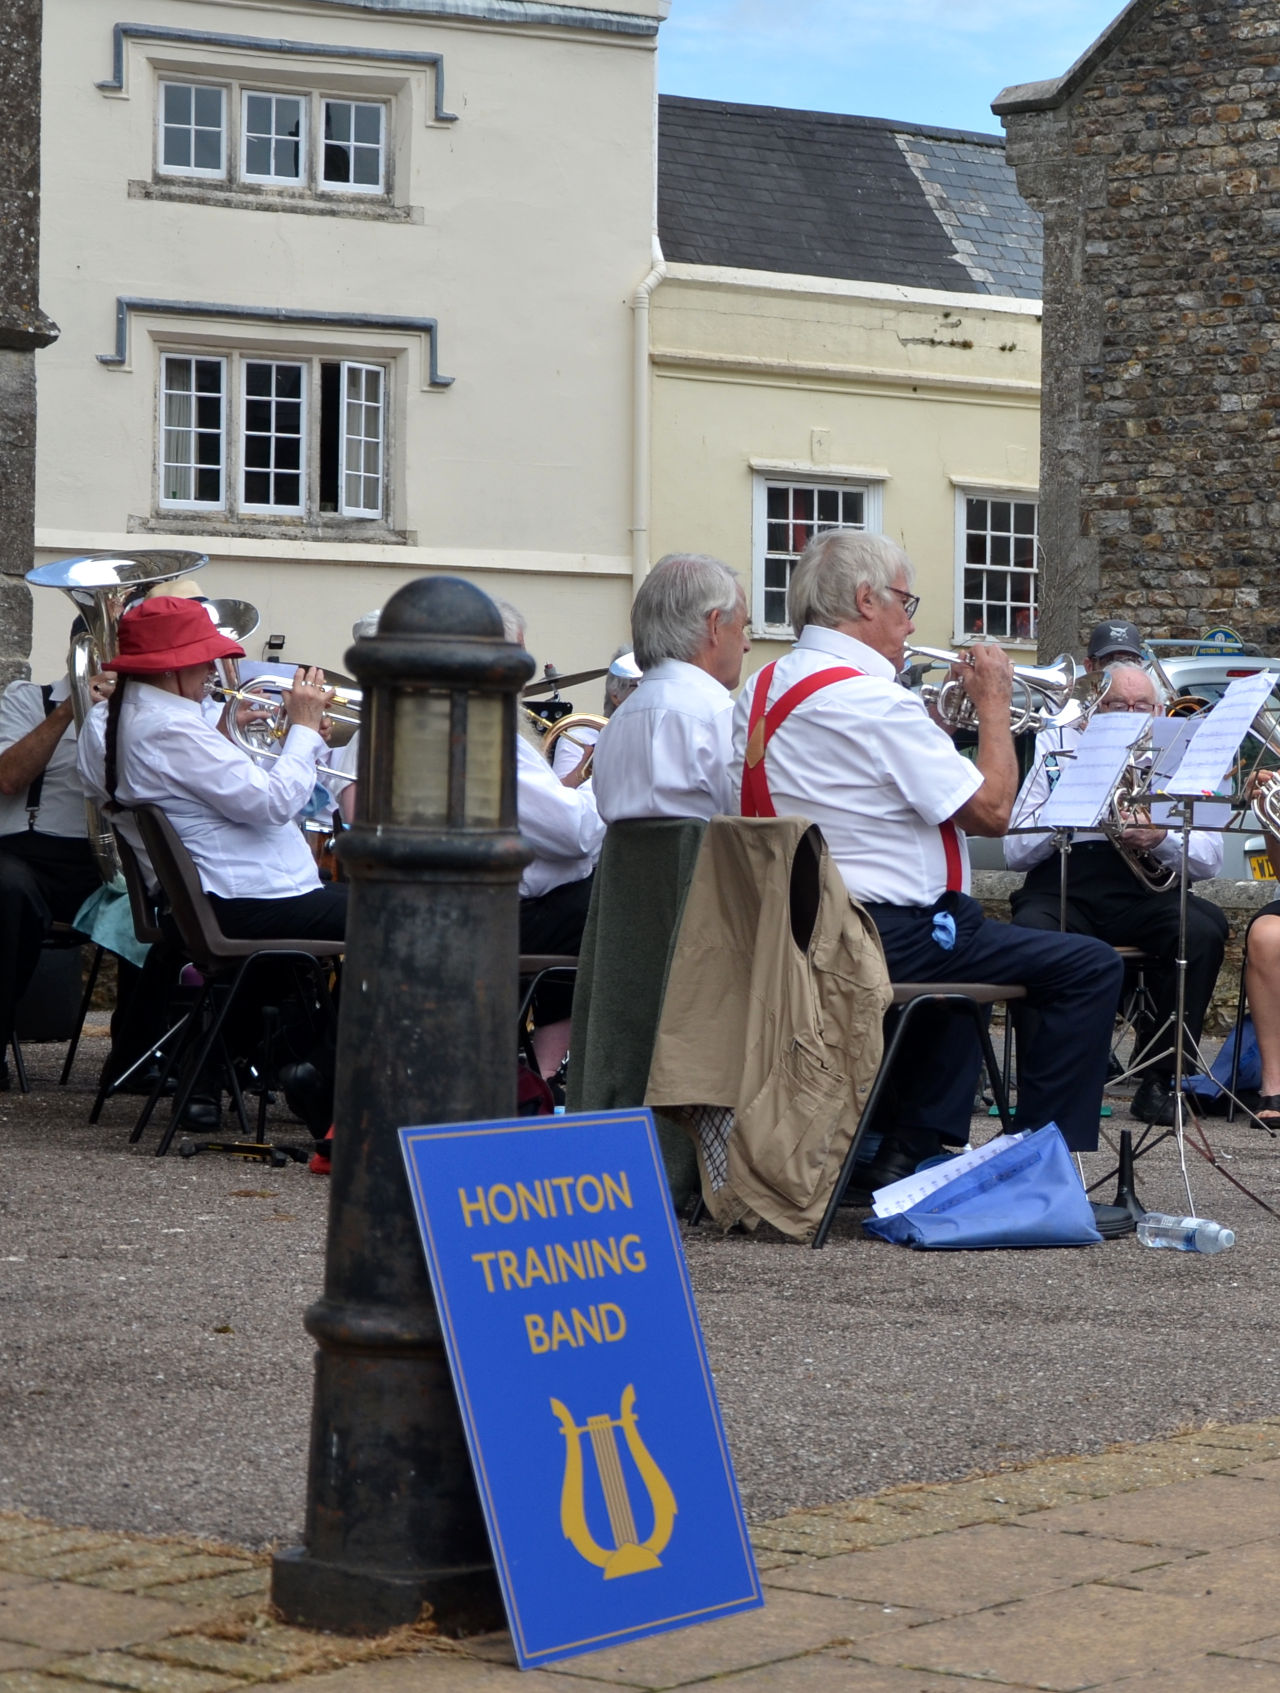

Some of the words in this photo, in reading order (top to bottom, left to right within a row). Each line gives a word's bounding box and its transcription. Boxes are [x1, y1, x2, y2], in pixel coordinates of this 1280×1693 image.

[458, 1171, 633, 1228] HONITON
[472, 1234, 646, 1293] TRAINING
[524, 1302, 627, 1355] BAND
